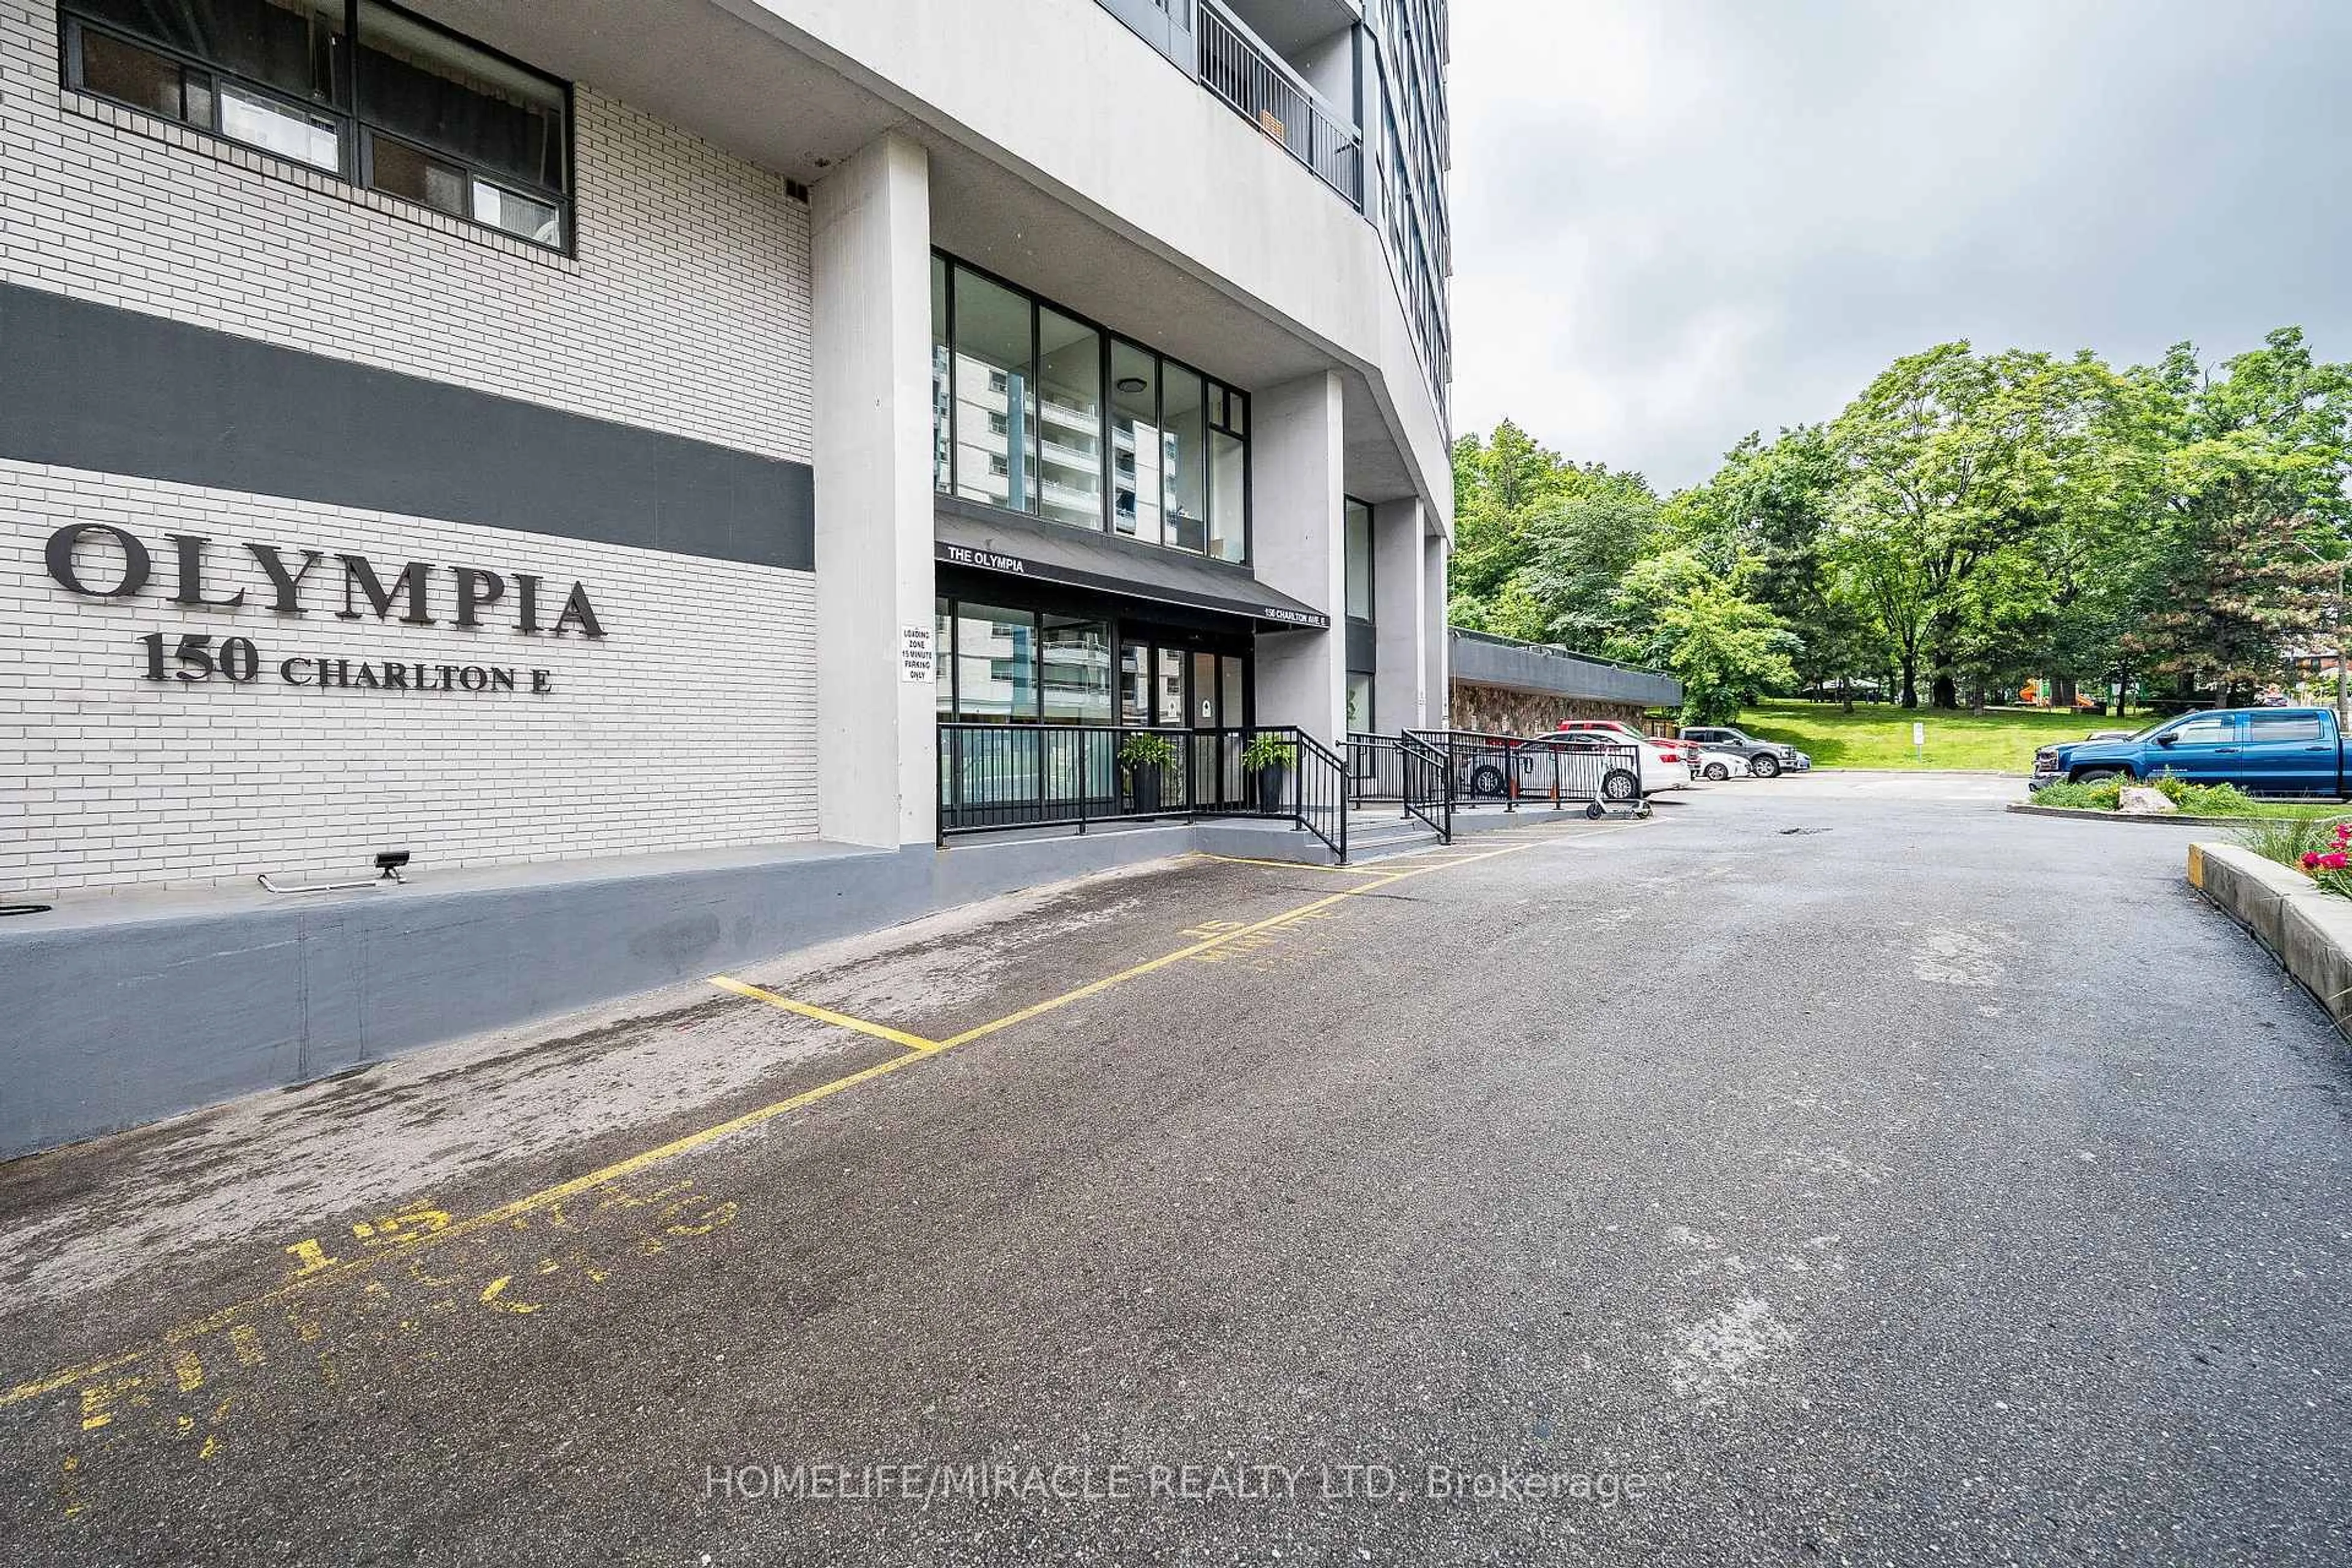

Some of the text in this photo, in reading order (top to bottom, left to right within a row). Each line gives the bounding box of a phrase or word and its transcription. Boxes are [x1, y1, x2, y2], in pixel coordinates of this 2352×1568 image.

[948, 546, 1023, 573] THE OLYMPIA
[44, 522, 608, 636] OLYMPIA
[904, 629, 930, 639] LOADING
[910, 640, 925, 649] ZONE
[910, 650, 932, 660] MINUTE
[136, 632, 552, 693] 150 CHARLTON E
[905, 660, 930, 670] PARKING
[910, 671, 925, 680] ONLY
